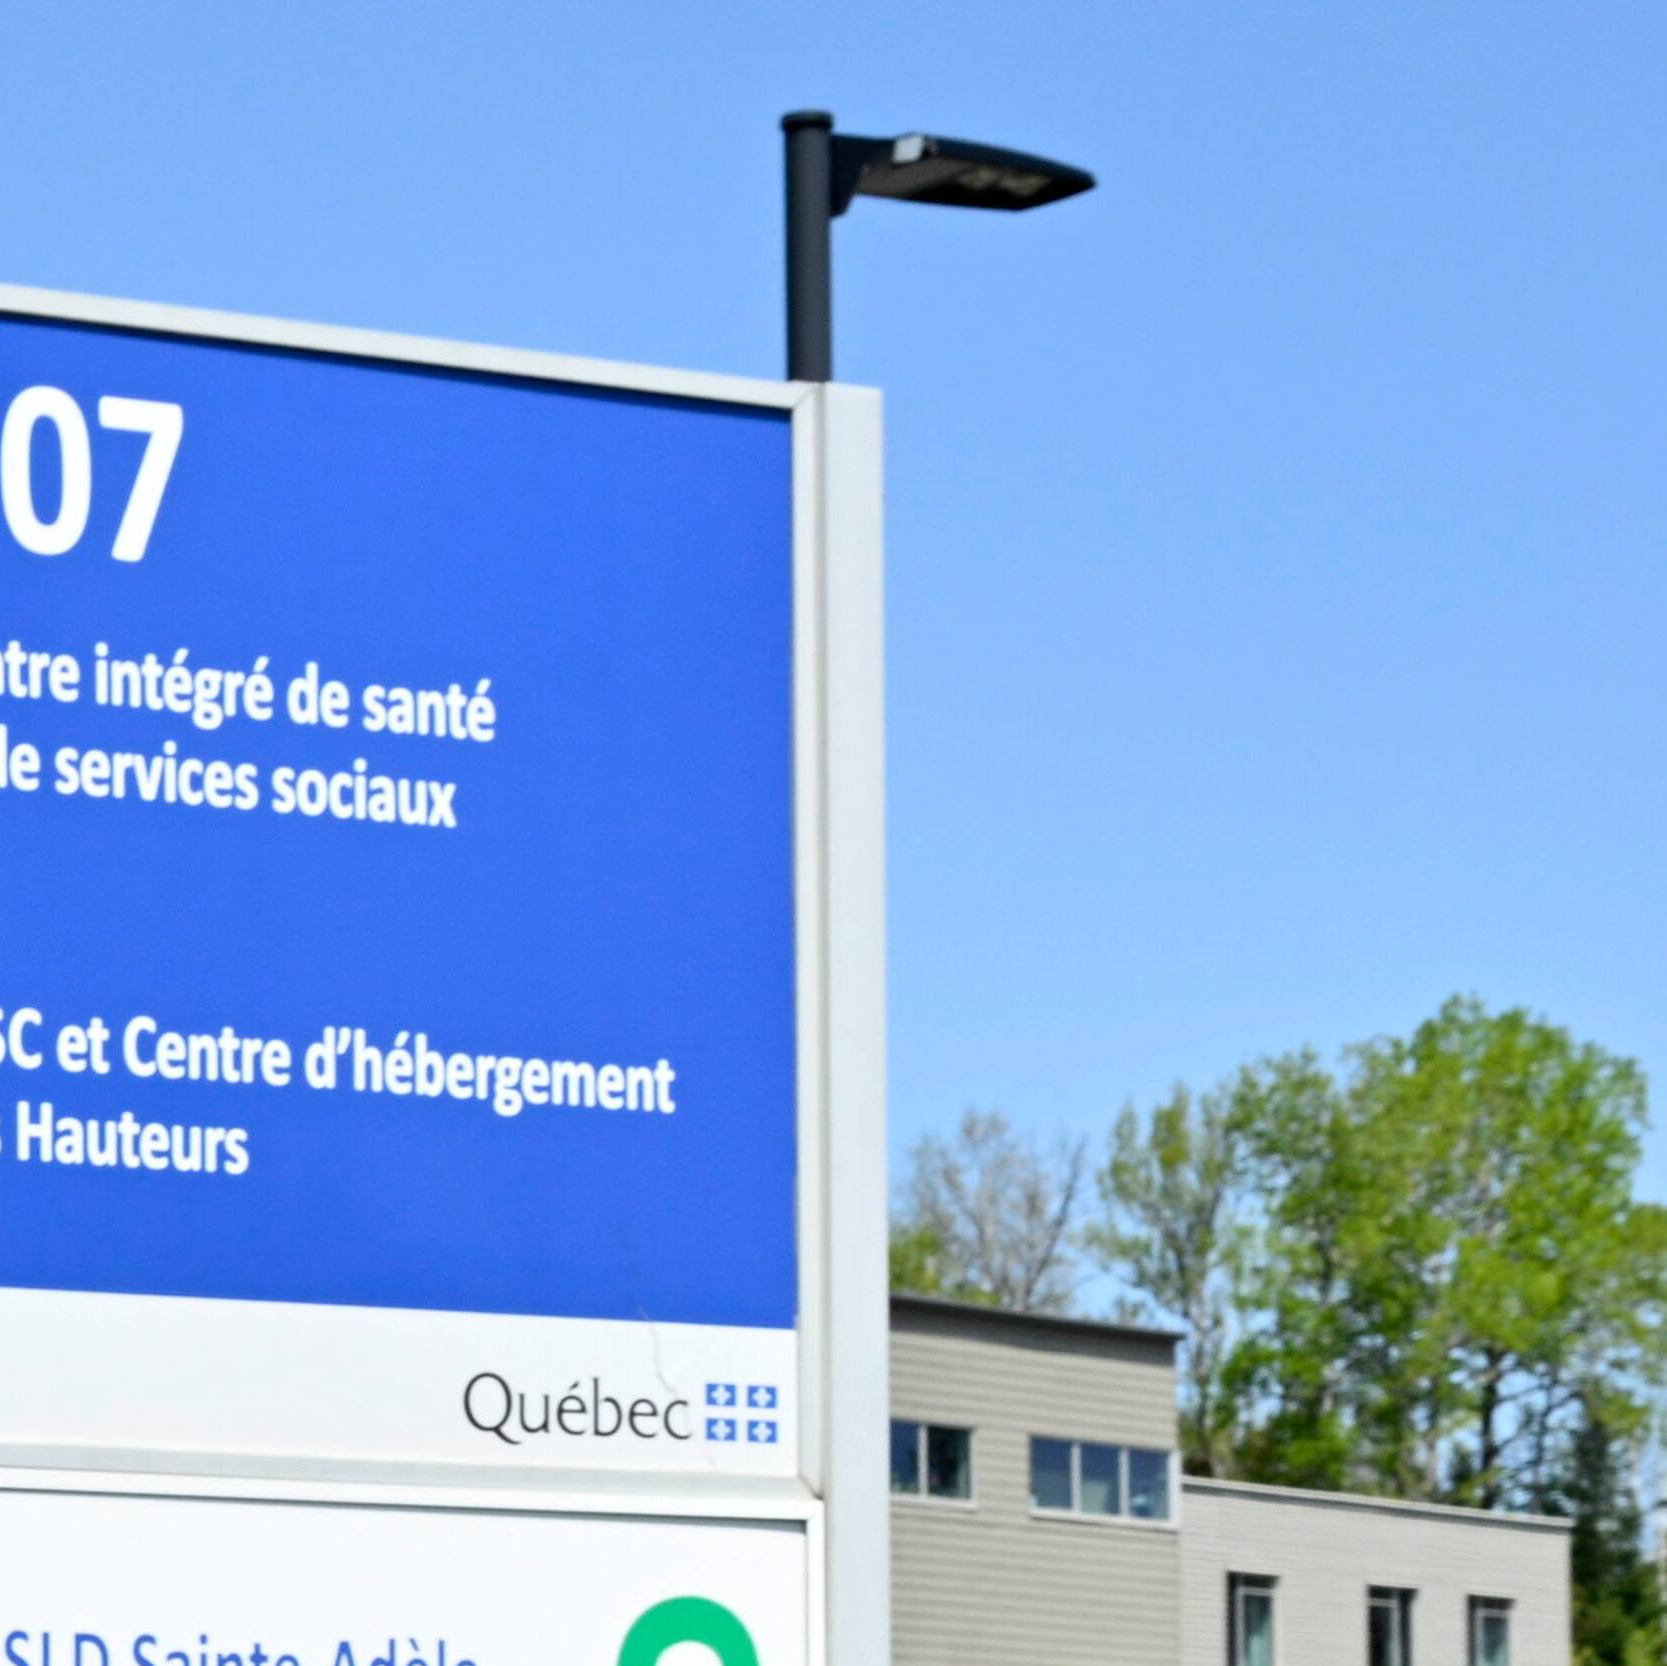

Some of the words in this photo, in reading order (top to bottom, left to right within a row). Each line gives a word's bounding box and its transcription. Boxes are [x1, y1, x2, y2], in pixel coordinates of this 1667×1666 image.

[94, 642, 274, 731] intégré
[287, 661, 350, 728] de
[362, 678, 496, 742] santé
[54, 740, 259, 811] services
[272, 757, 457, 828] sociaux
[56, 1017, 110, 1075] et
[123, 1015, 292, 1087] Centre
[304, 1026, 676, 1117] d’hébergement
[17, 1100, 250, 1175] Hauteurs
[463, 1371, 693, 1446] Québec
